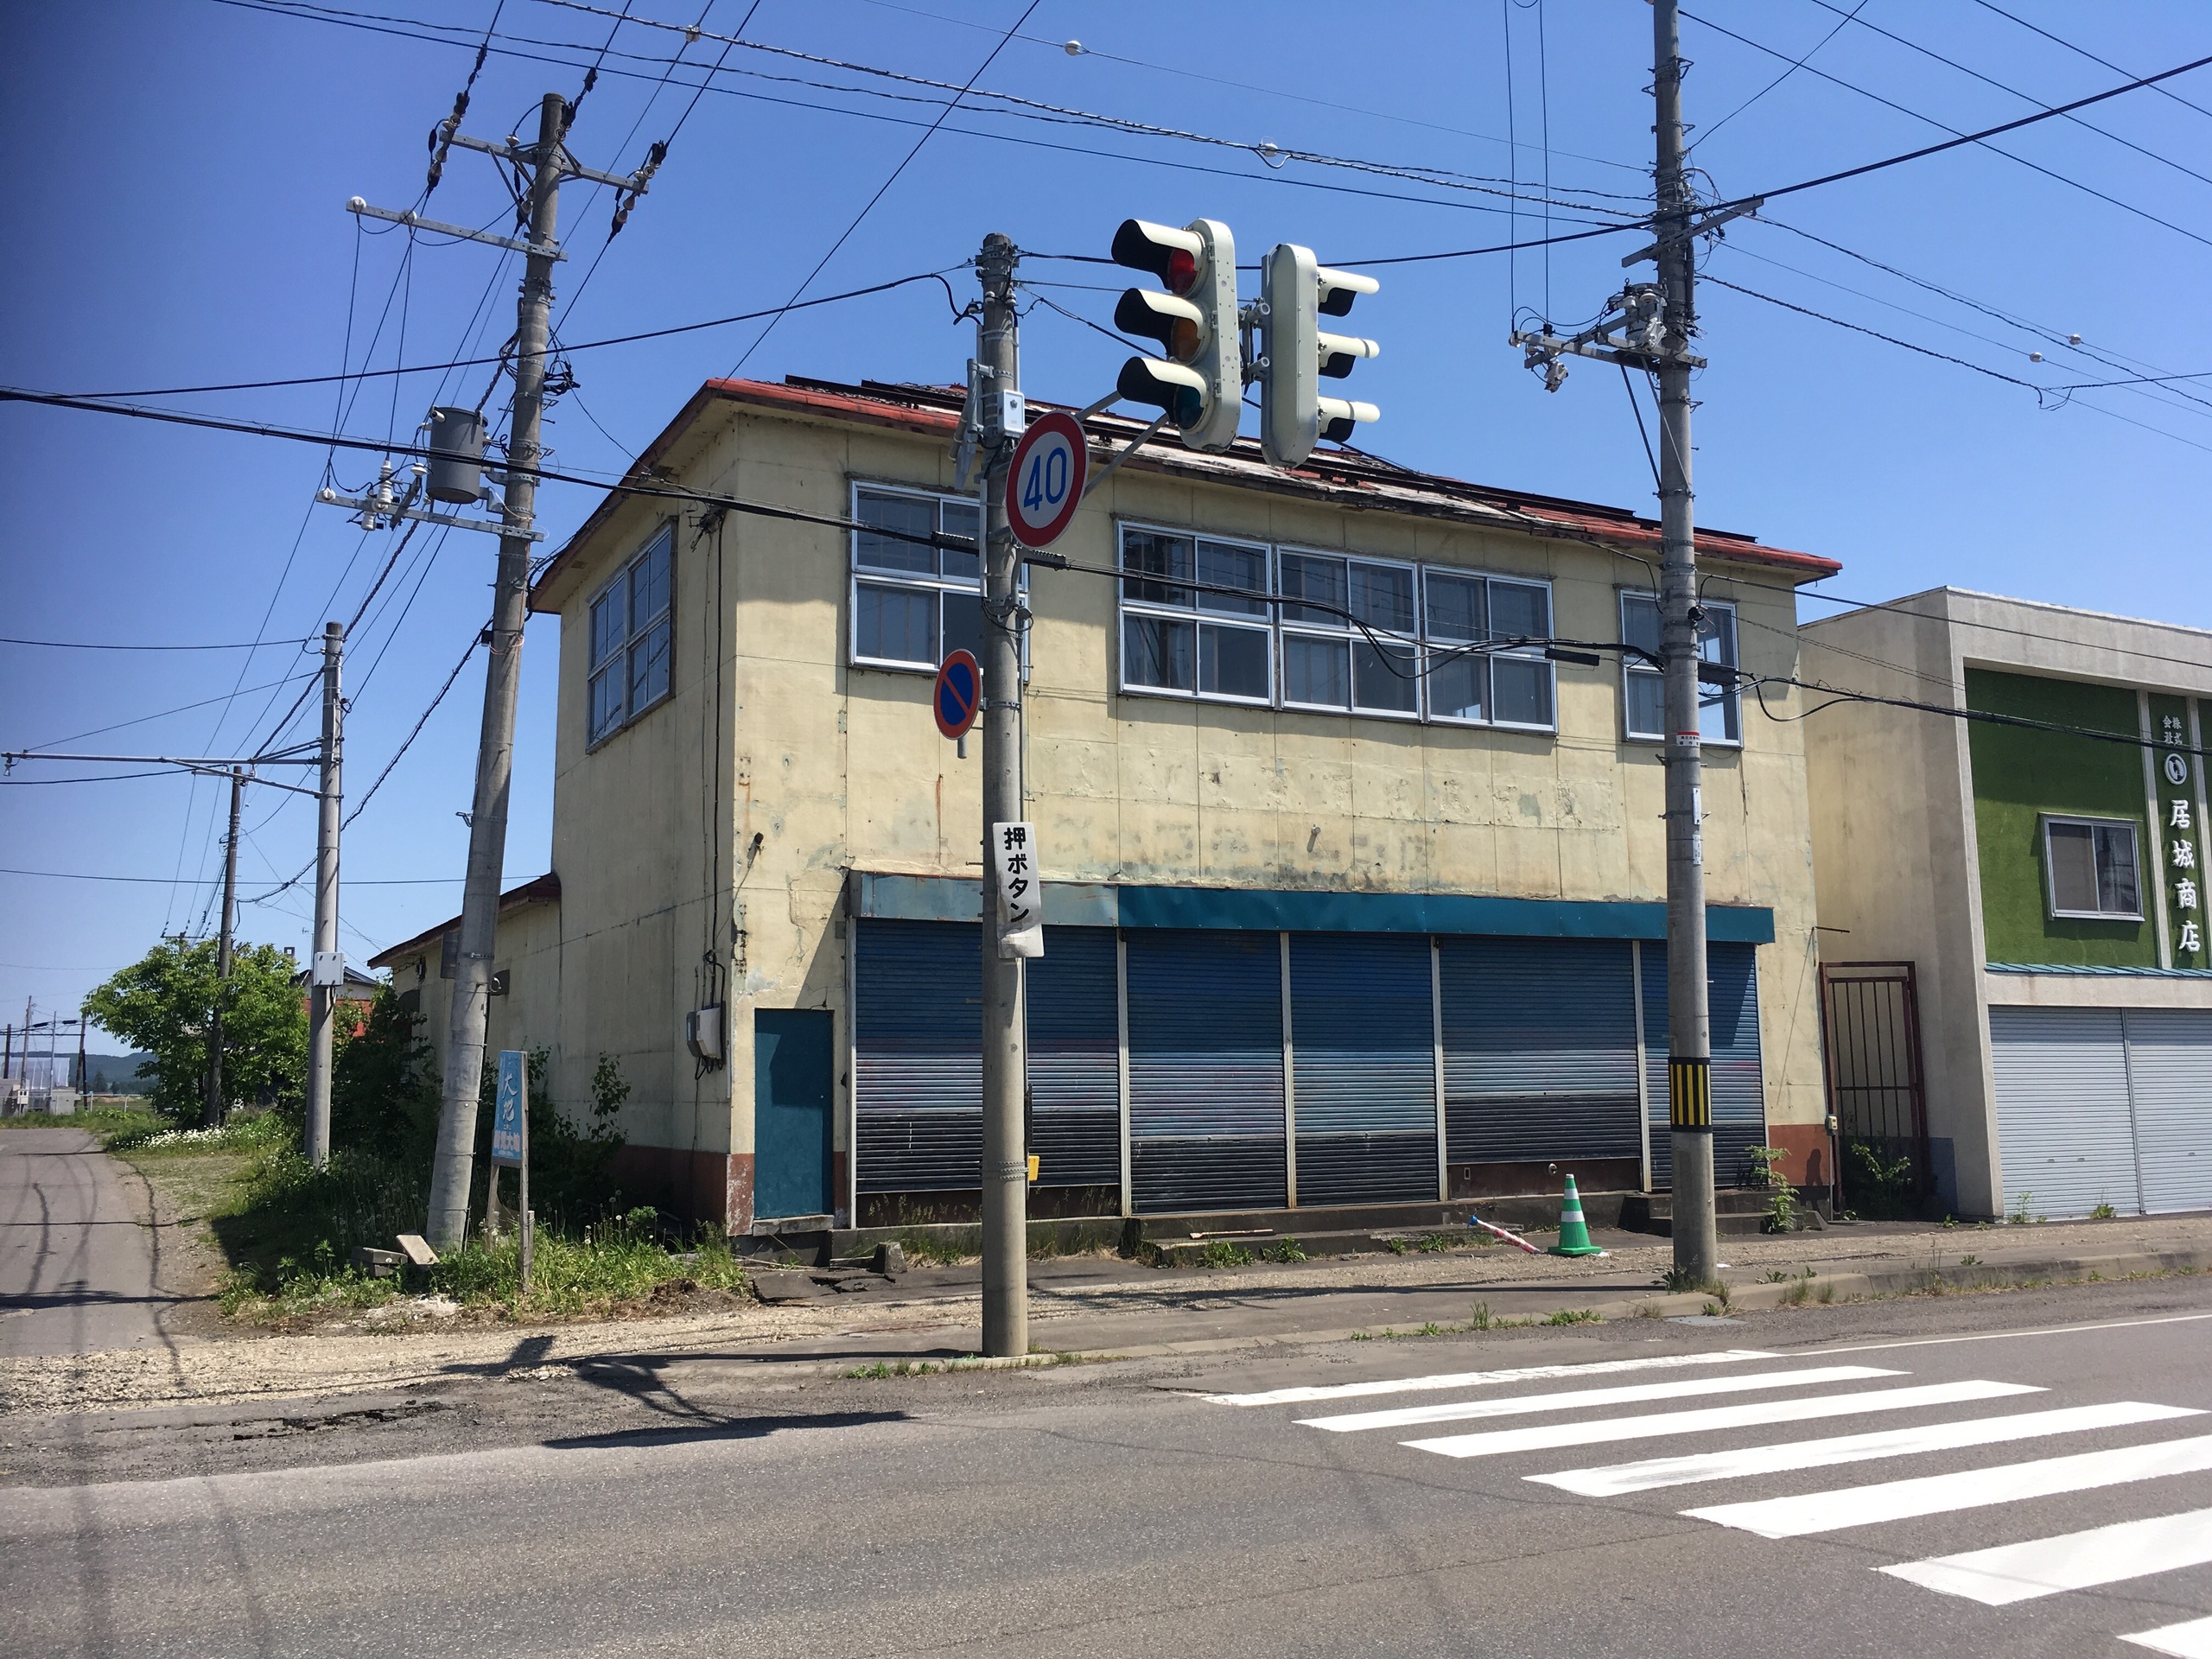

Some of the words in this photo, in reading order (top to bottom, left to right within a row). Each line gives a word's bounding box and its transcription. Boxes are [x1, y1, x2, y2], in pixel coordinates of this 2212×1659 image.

[1023, 447, 1067, 512] 40
[1004, 827, 1029, 923] 押ボタン
[2170, 799, 2201, 952] 居城商店
